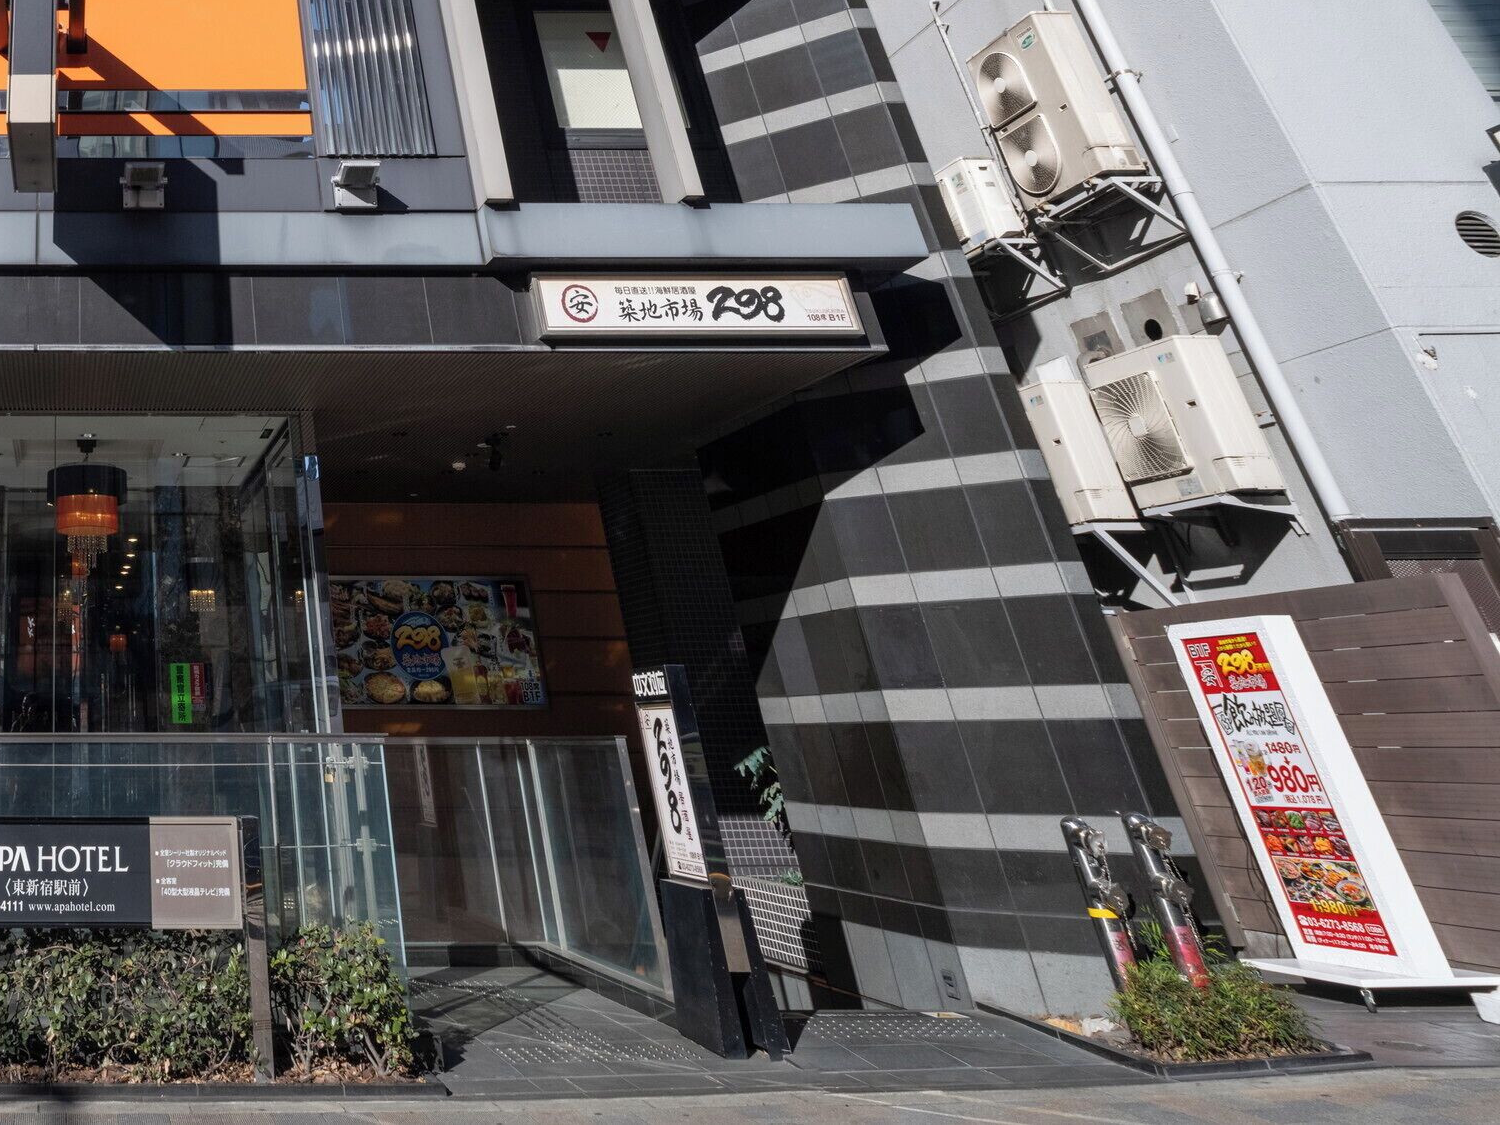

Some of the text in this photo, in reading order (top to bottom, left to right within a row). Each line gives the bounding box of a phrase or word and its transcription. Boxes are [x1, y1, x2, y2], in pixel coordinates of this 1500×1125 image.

[618, 286, 786, 323] 築地市場 298
[828, 313, 846, 322] B1F
[394, 624, 442, 652] 298
[1187, 643, 1211, 658] B1F
[1216, 649, 1257, 677] 298
[523, 691, 541, 702] B1F
[1265, 742, 1301, 754] 1480円
[653, 717, 683, 835] 298
[1267, 764, 1322, 793] 980円
[37, 845, 129, 872] HOTEL
[28, 901, 116, 914] www.apahotel.com
